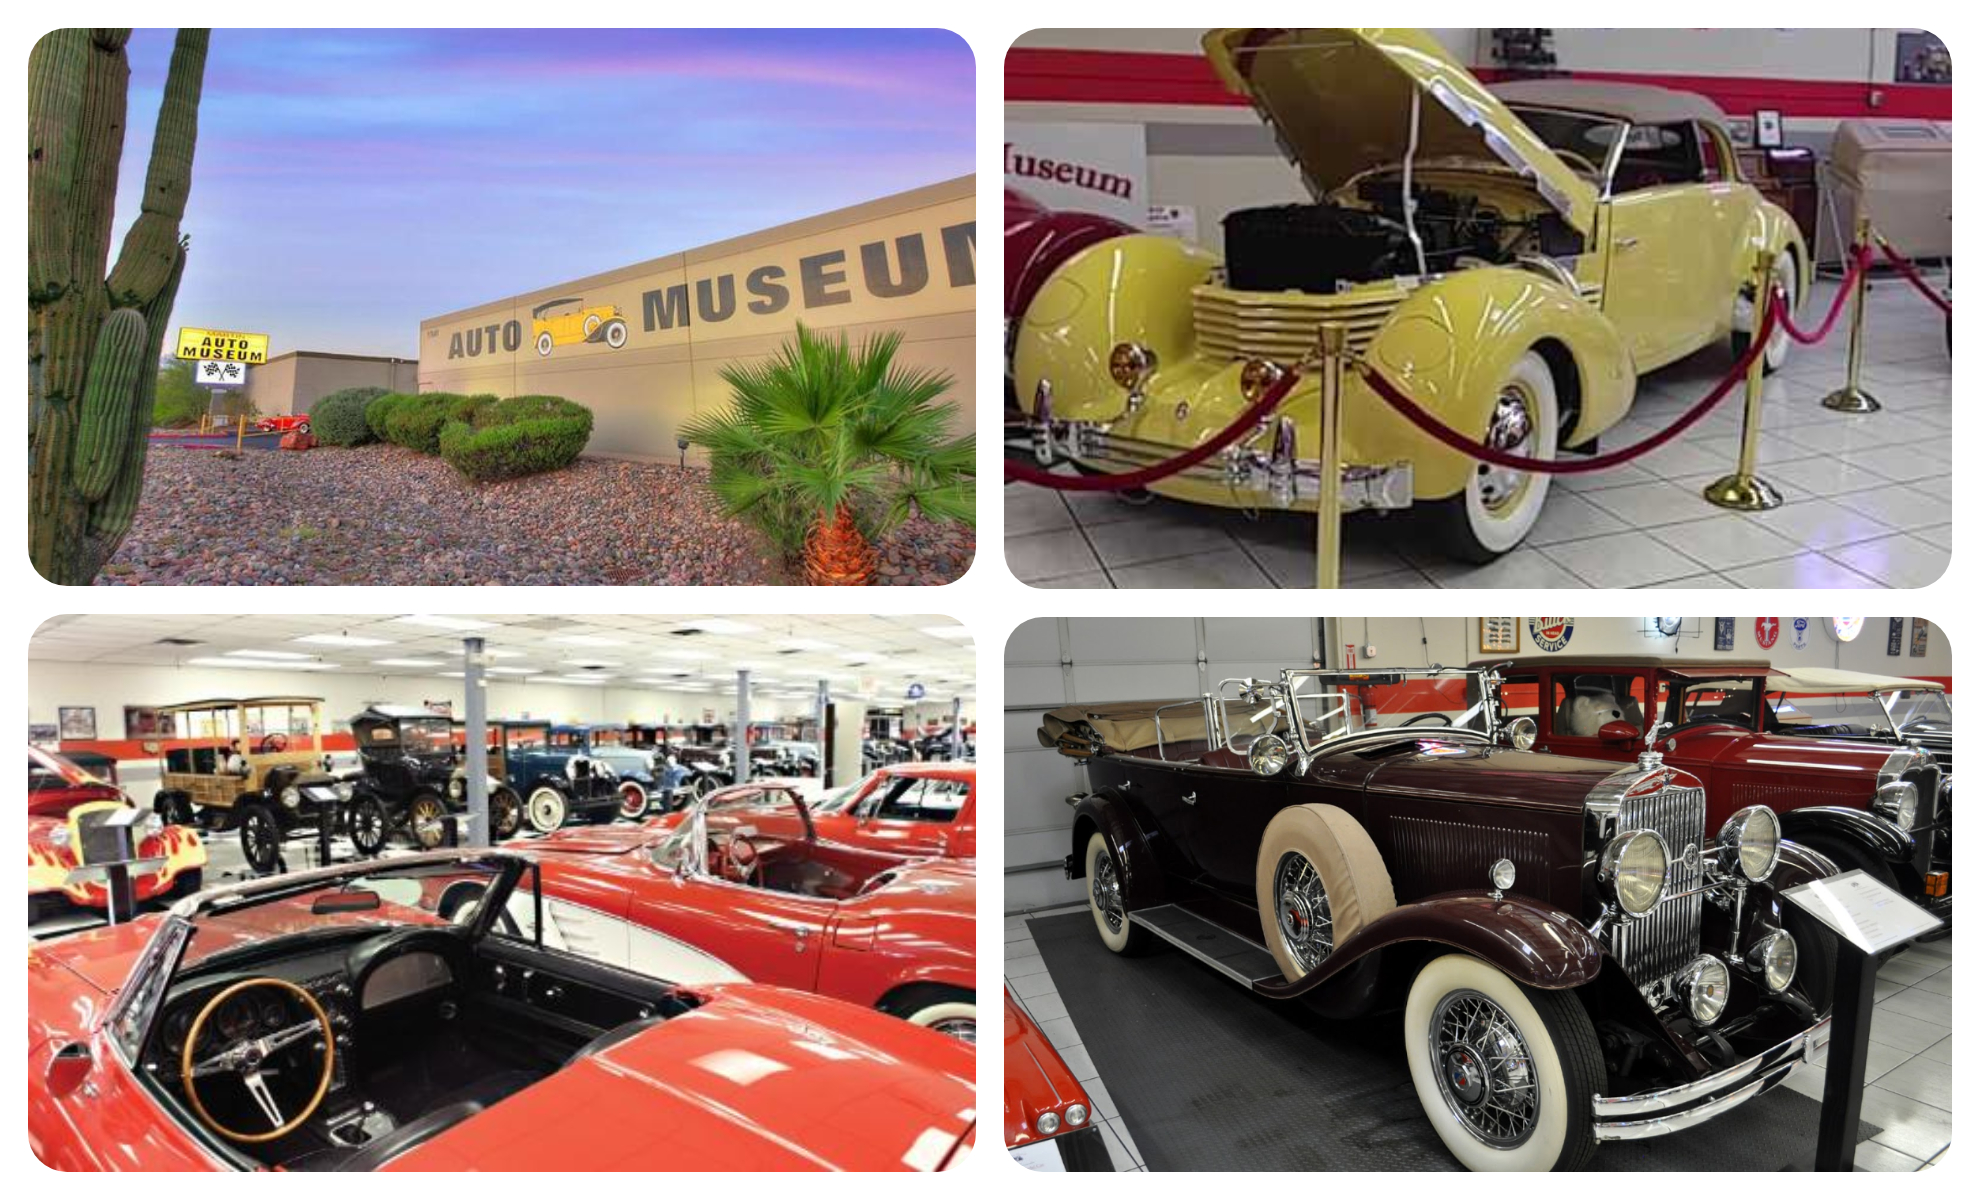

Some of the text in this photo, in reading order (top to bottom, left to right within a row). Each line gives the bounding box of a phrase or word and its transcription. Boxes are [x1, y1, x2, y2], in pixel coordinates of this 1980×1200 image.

[202, 337, 248, 349] AUTO
[448, 320, 522, 360] AUTO
[183, 347, 262, 361] MUSEUM
[1535, 635, 1567, 651] SERVICE
